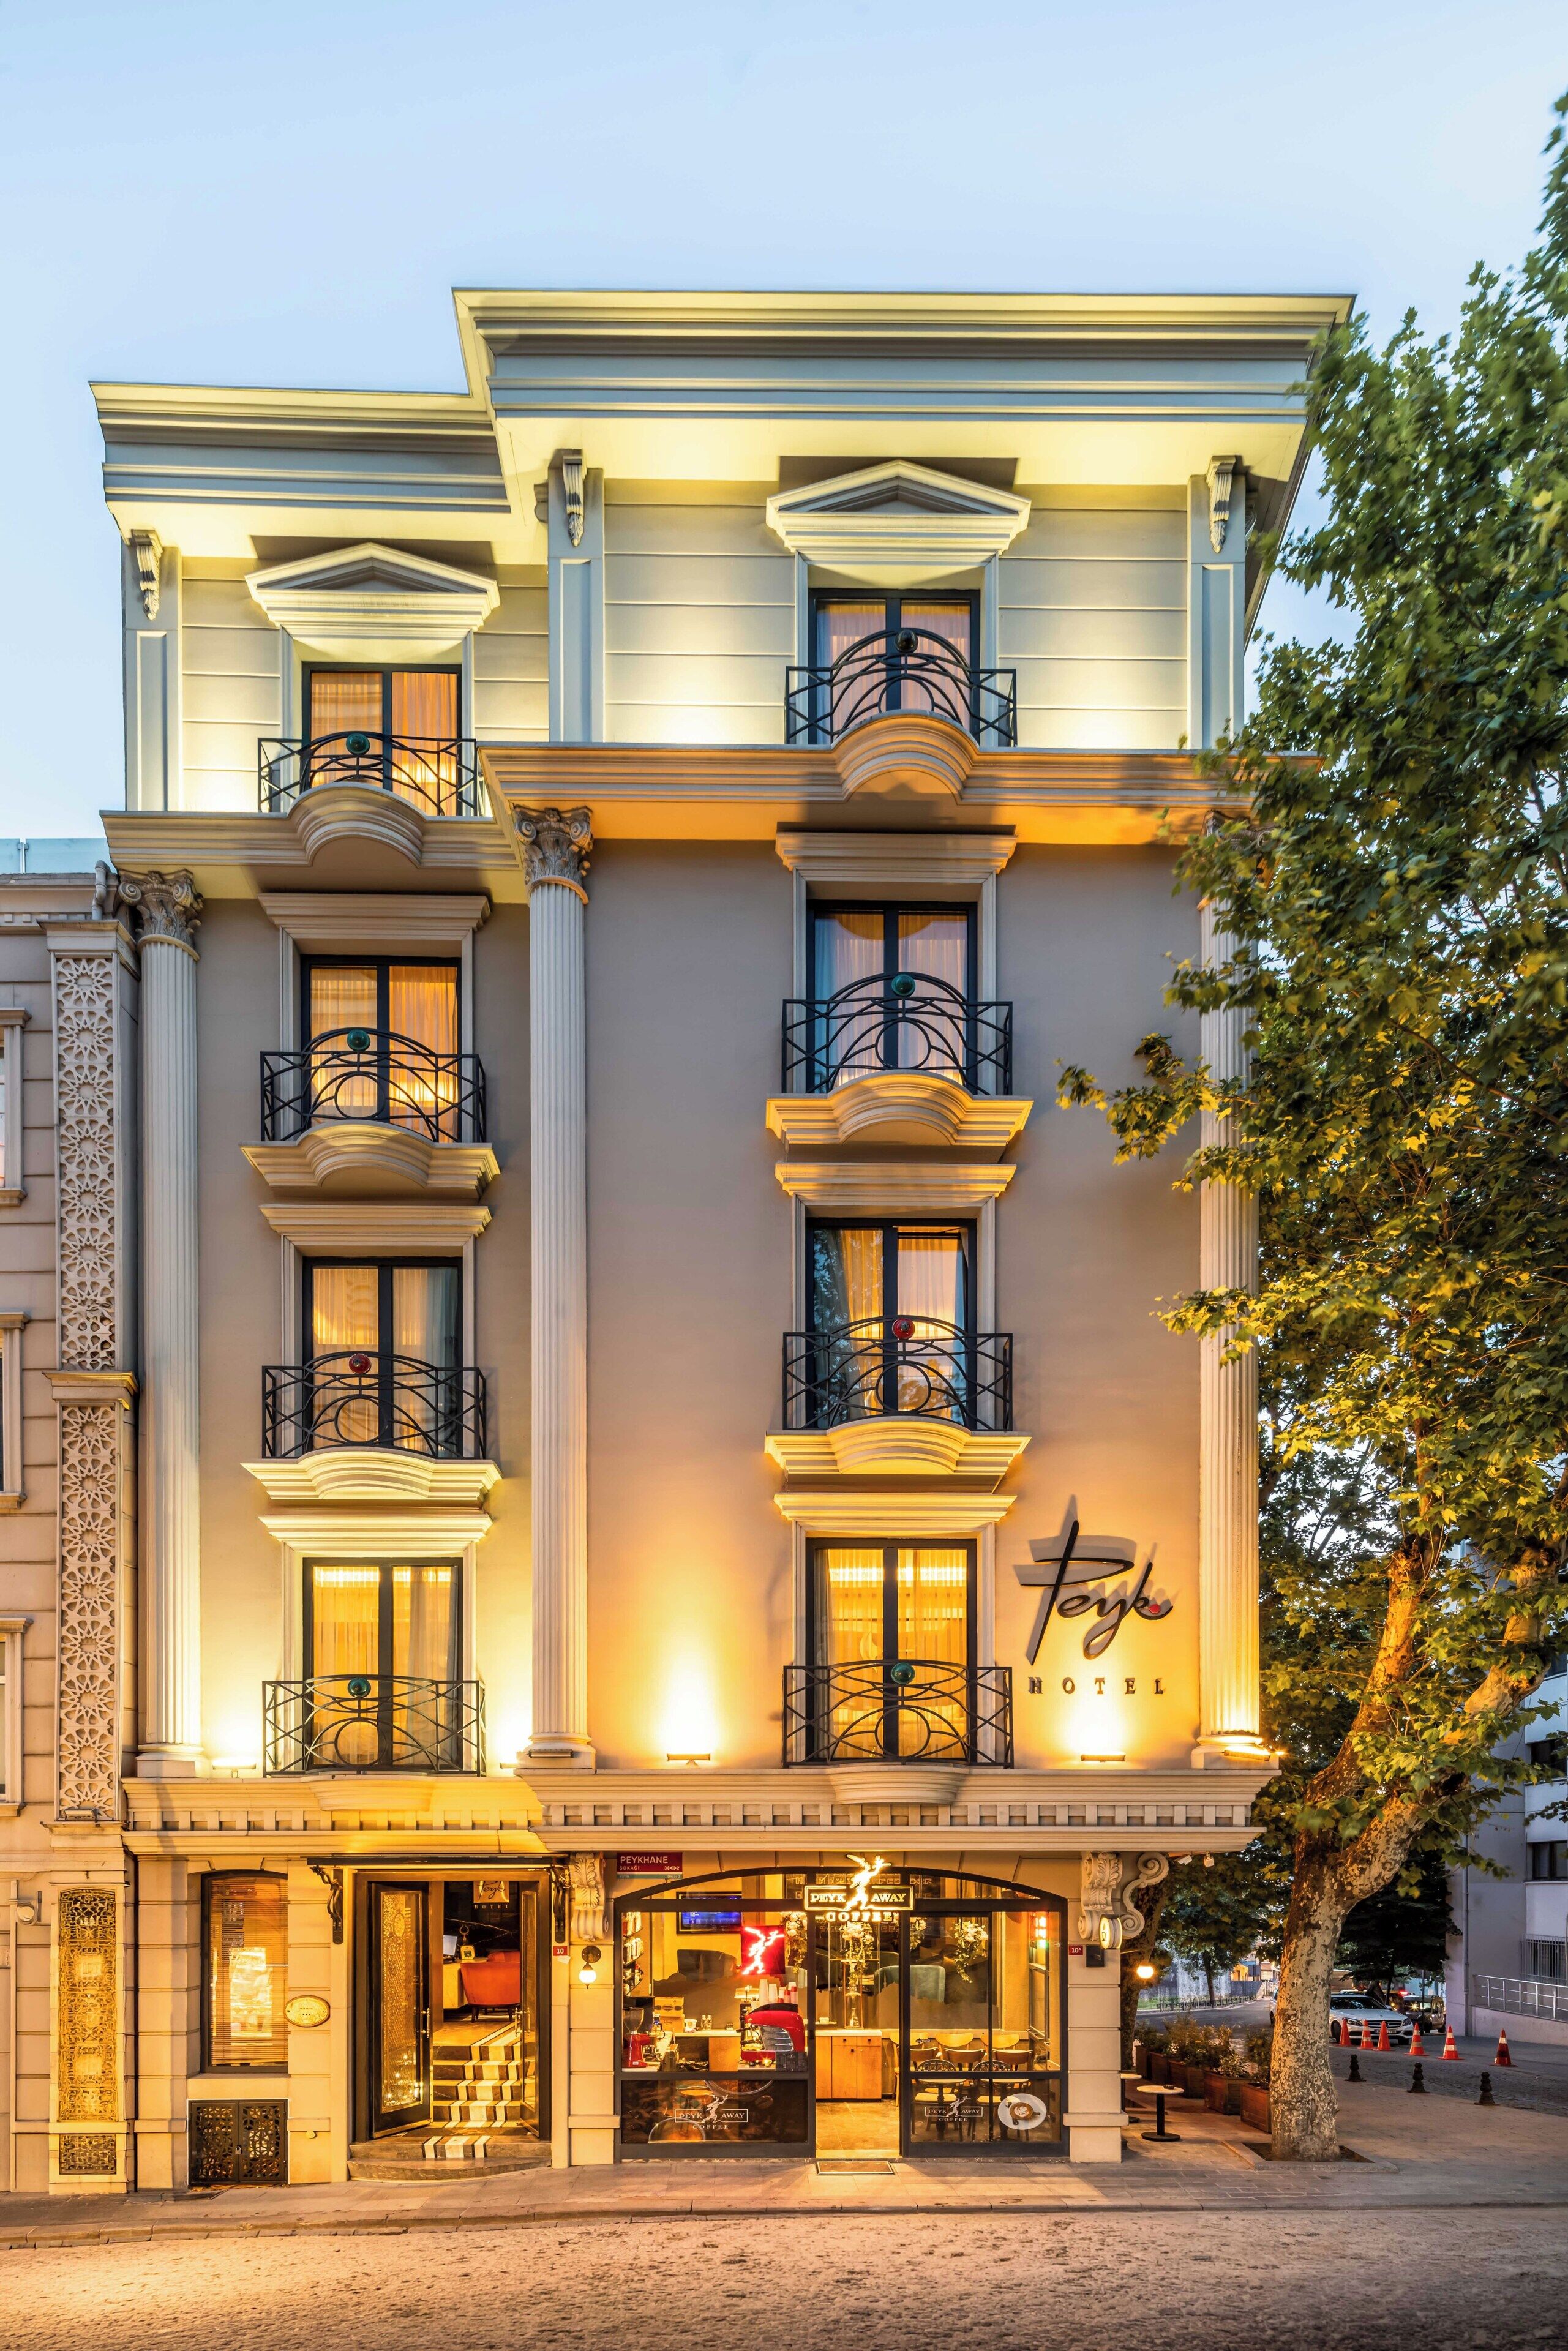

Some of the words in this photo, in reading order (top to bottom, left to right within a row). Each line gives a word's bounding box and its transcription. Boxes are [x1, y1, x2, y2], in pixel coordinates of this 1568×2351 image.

[1019, 1520, 1174, 1665] Peyk
[1029, 1677, 1165, 1695] HOTEL
[809, 1893, 846, 1903] PEYK
[871, 1893, 907, 1902] AWAY
[825, 1911, 893, 1922] COFFEE
